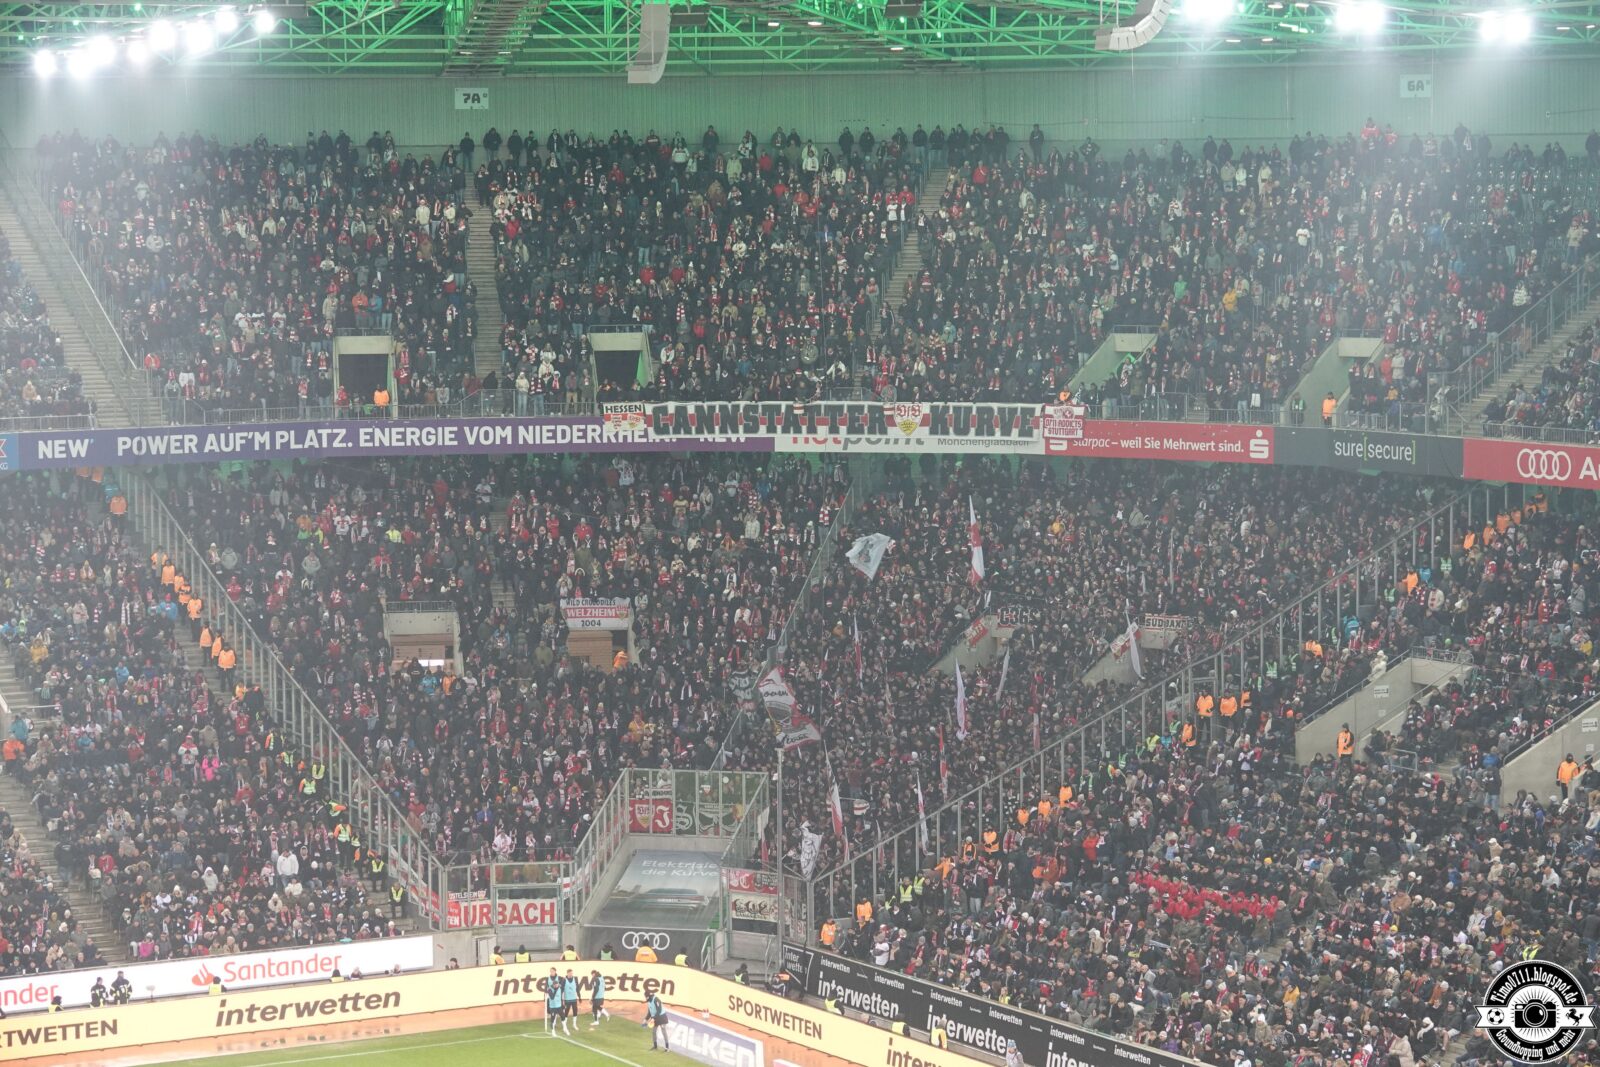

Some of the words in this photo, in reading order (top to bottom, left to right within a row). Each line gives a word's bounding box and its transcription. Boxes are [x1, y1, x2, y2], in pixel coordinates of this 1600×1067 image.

[462, 93, 481, 104] 7A
[605, 404, 642, 414] HESSEN
[652, 403, 889, 436] CANNSTATTER
[928, 406, 1036, 438] KURVE
[117, 434, 198, 457] POWER
[204, 430, 271, 453] AUF'M
[275, 427, 354, 450] PLATZ.
[359, 426, 459, 447] ENERGIE
[464, 425, 512, 446] VOM
[1121, 437, 1141, 449] weil
[1144, 437, 1161, 449] Sie
[1163, 439, 1216, 452] Mehrwert
[1218, 440, 1245, 453] sind.
[567, 607, 616, 617] WELZHEIM
[581, 619, 601, 627] 2004
[670, 868, 719, 877] Kurve
[224, 953, 342, 983] Santander
[820, 956, 851, 974] interwetten
[493, 969, 676, 996] intewetten
[874, 972, 905, 990] interwetten
[0, 983, 58, 1006] nder
[930, 989, 963, 1008] interwetten
[216, 990, 401, 1028] interwetten
[727, 994, 823, 1040] SPORTWETTEN
[988, 1006, 1023, 1026] interwetten
[0, 1018, 119, 1049] TWETTEN
[1049, 1025, 1085, 1046] interwetten
[1113, 1044, 1151, 1065] interwetten
